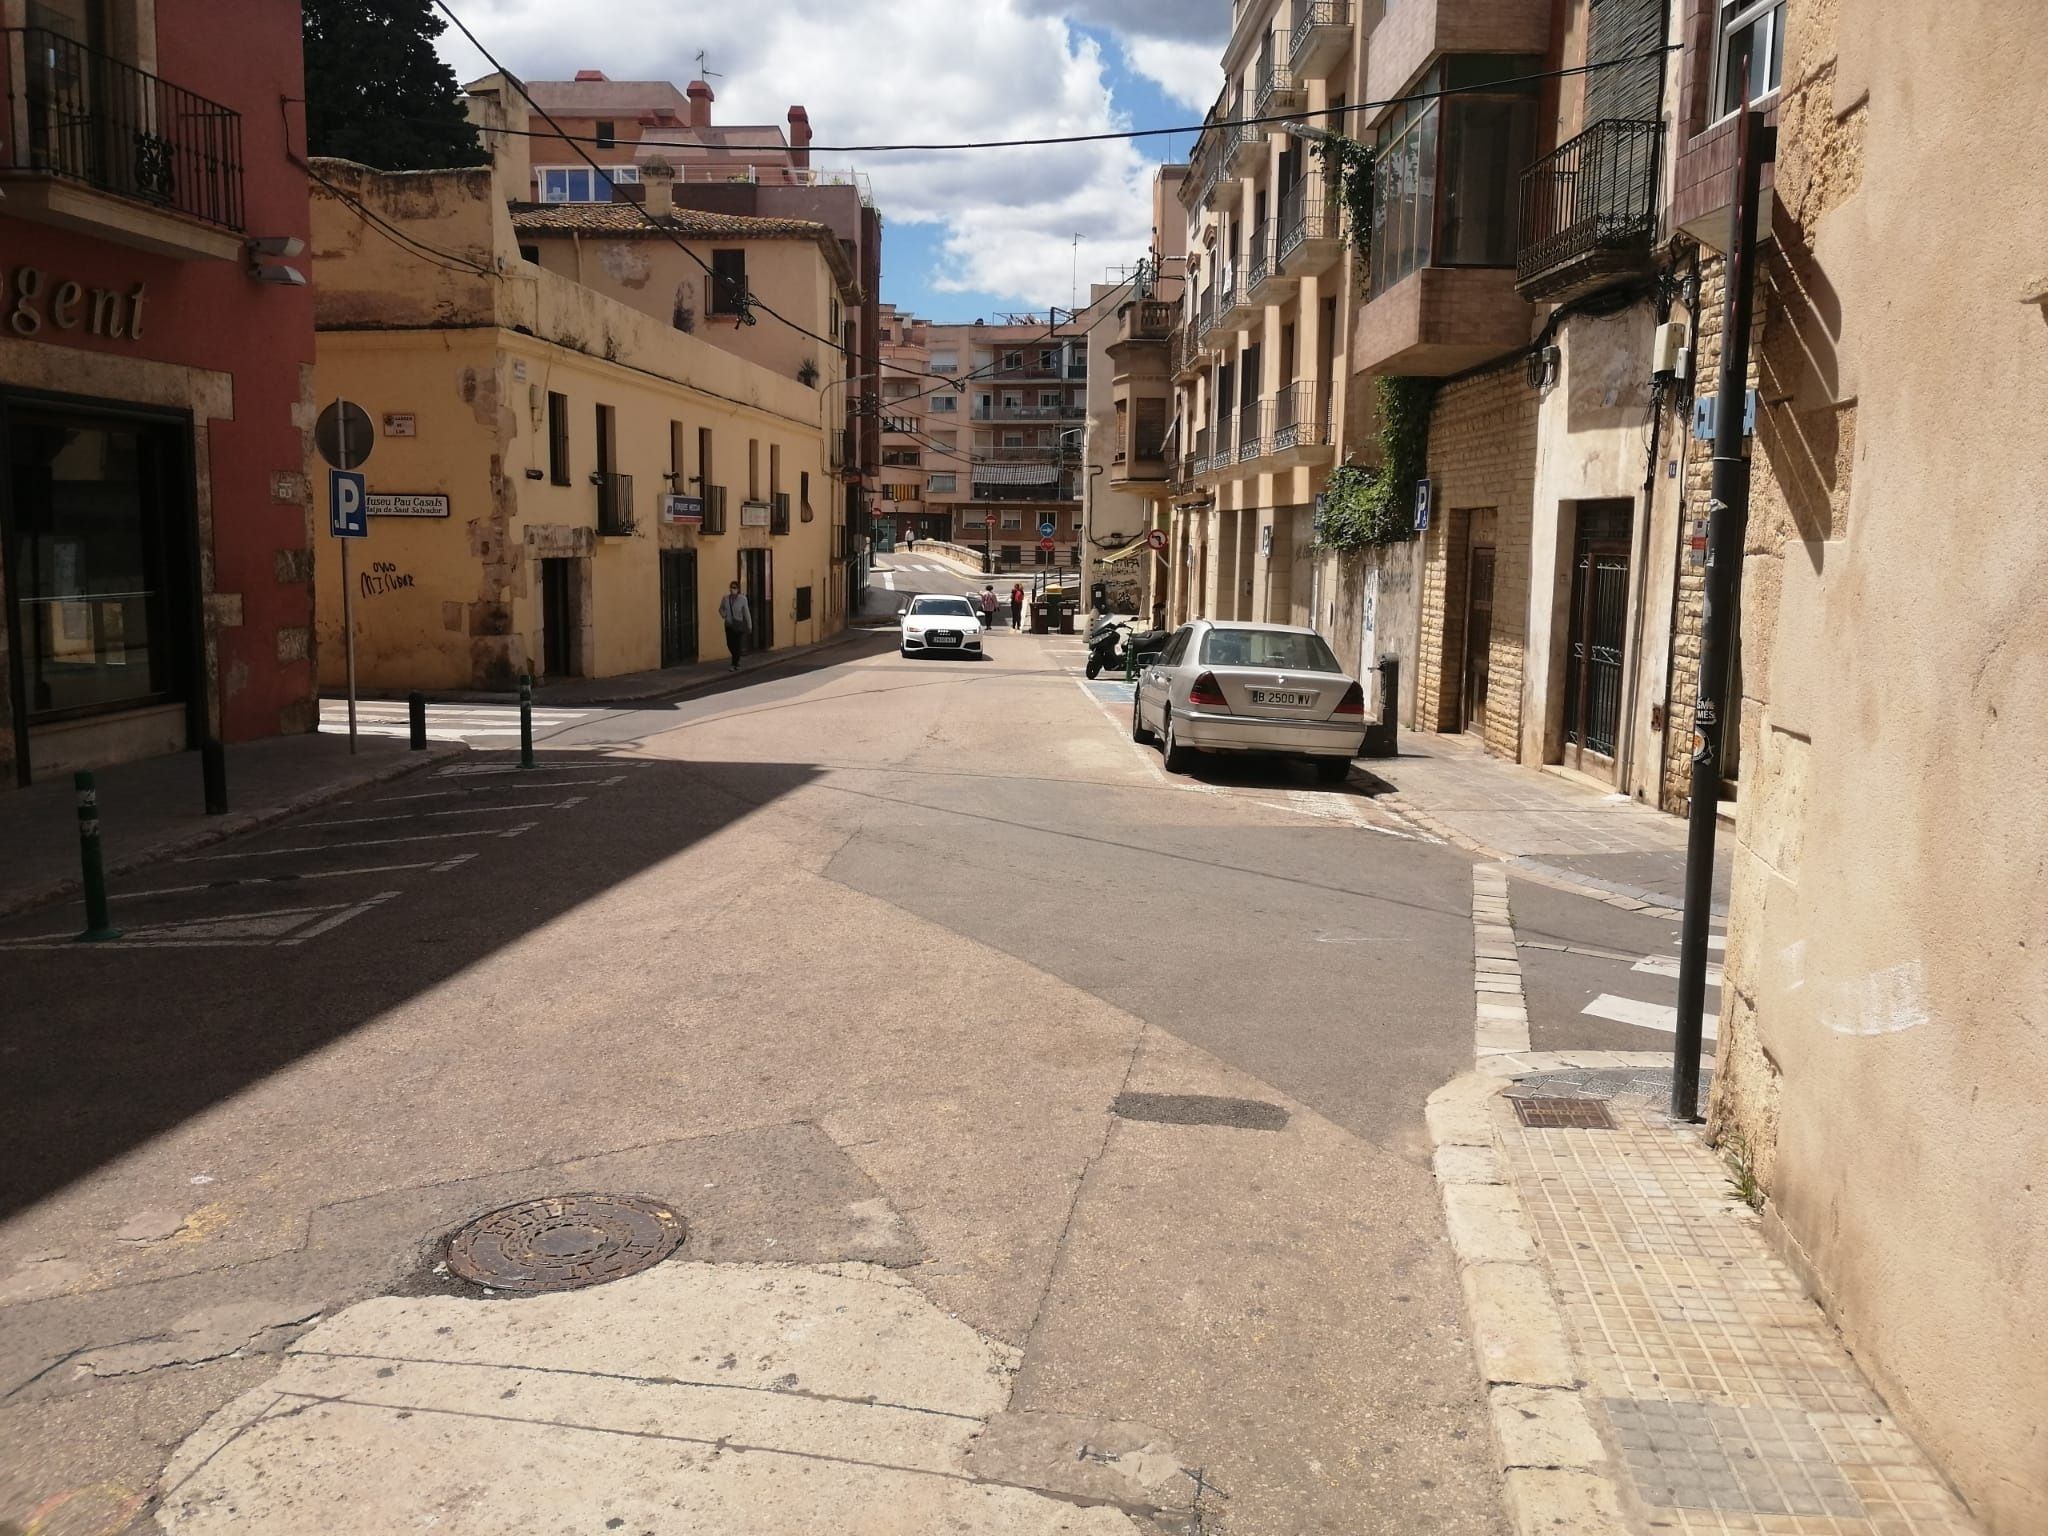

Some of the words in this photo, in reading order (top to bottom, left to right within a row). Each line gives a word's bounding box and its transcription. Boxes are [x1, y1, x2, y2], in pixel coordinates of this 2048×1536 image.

[0, 266, 148, 341] gent
[338, 478, 360, 529] P
[394, 497, 411, 506] Pau
[413, 497, 442, 507] Casals
[1258, 691, 1265, 702] B
[1268, 692, 1295, 704] 2500
